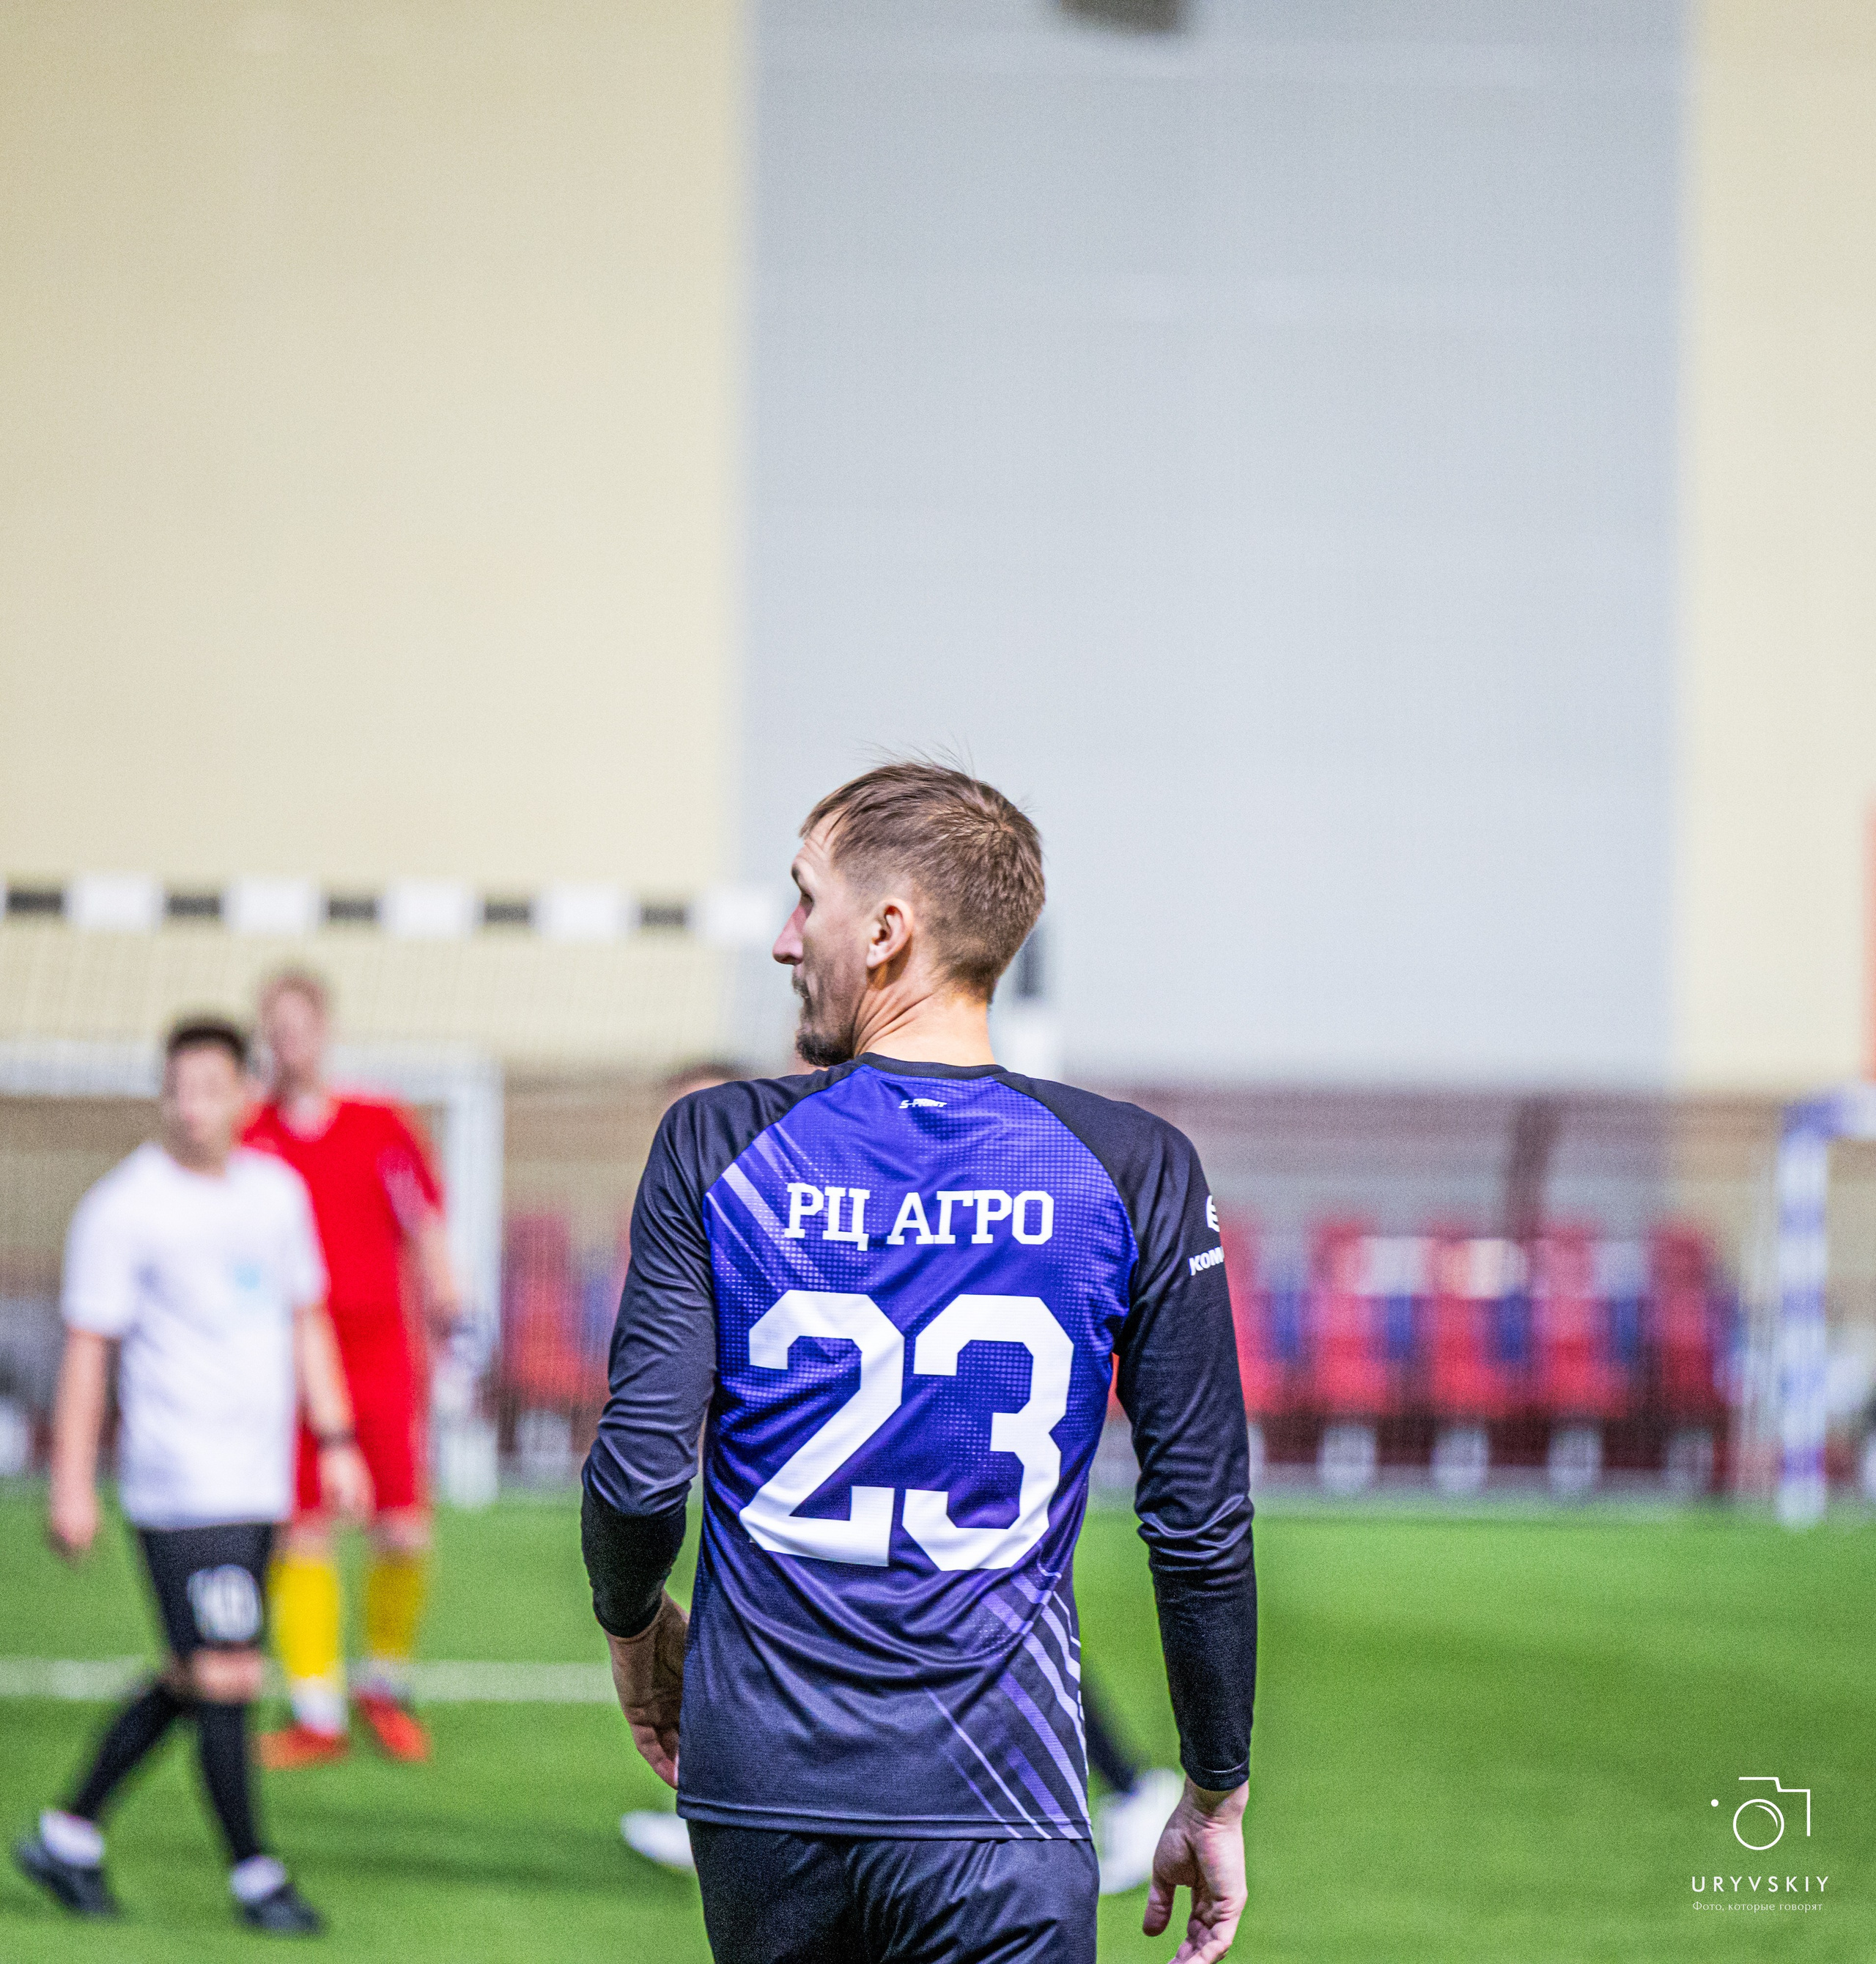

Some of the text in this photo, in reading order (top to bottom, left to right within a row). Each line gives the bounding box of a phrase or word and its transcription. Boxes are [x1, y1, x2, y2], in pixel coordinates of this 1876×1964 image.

[784, 1182, 1055, 1252] РЦ АГРО
[739, 1289, 1074, 1572] 23
